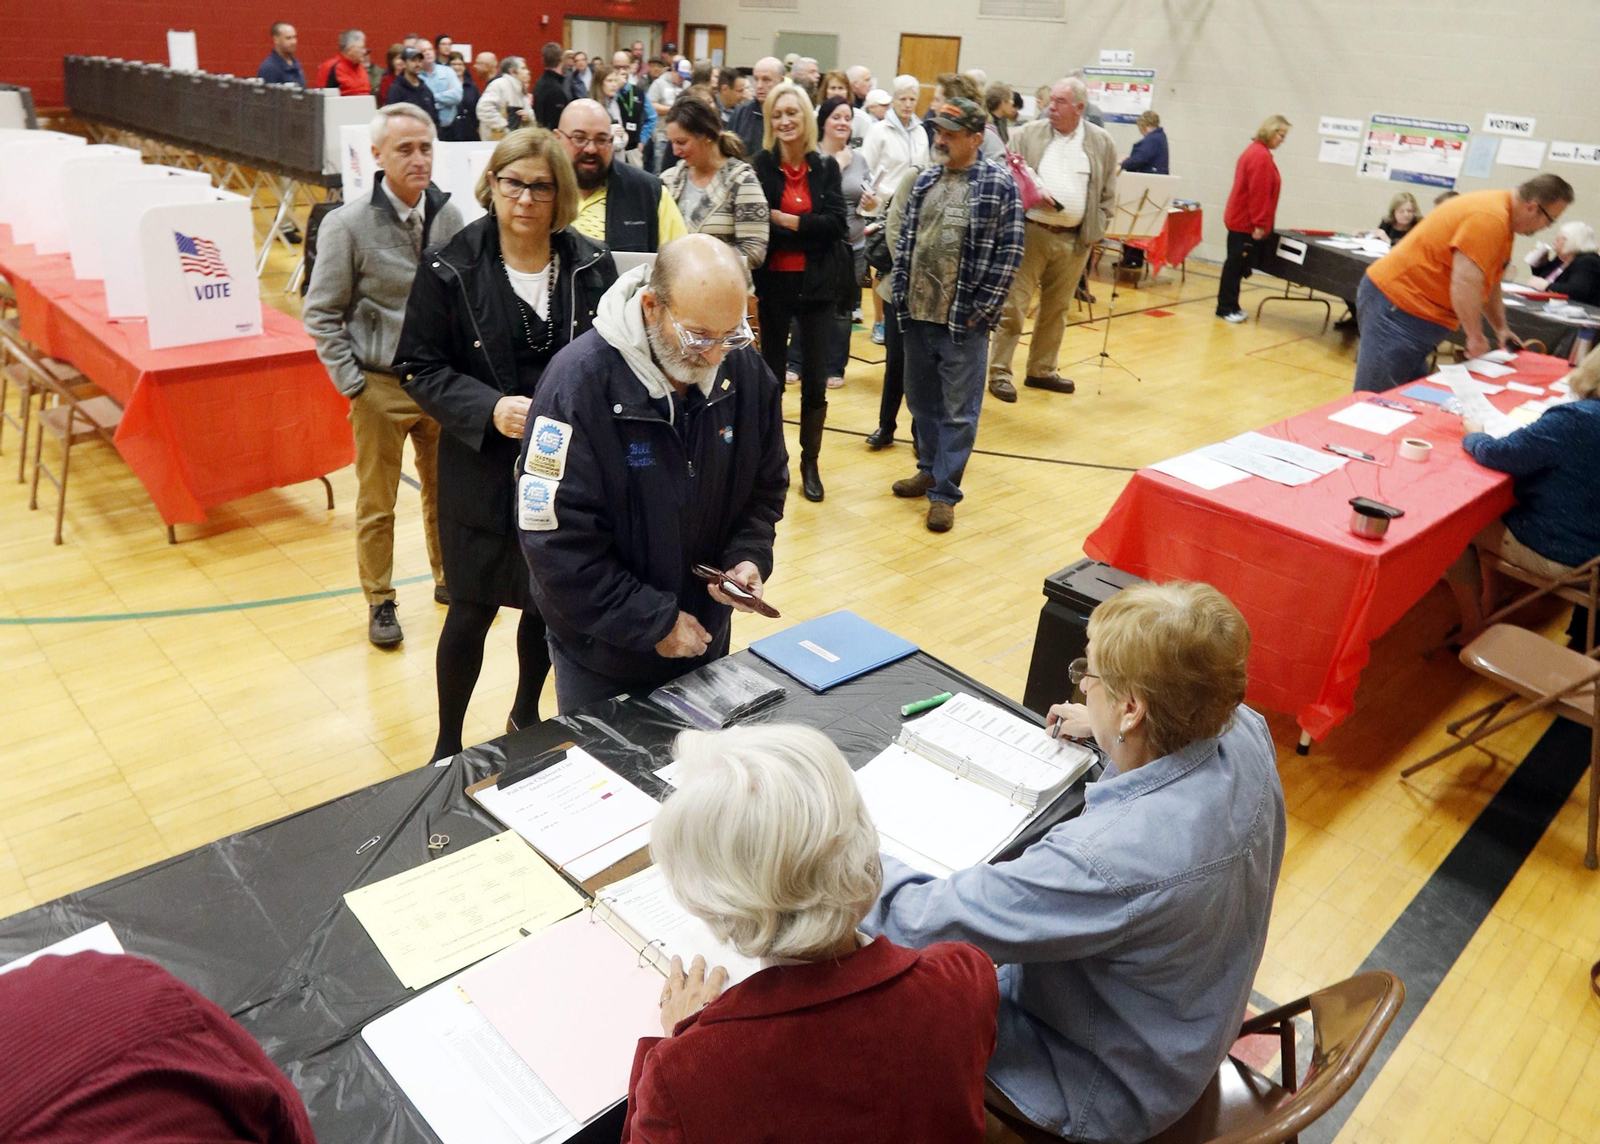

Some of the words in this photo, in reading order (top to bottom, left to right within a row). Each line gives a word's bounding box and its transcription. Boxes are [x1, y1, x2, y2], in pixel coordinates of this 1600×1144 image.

[1489, 119, 1530, 132] VOTING
[195, 282, 231, 301] VOTE
[539, 431, 561, 448] ASE
[630, 443, 651, 455] Bill
[535, 454, 556, 463] MASTER
[526, 486, 545, 499] ASE
[528, 774, 562, 792] Instructions
